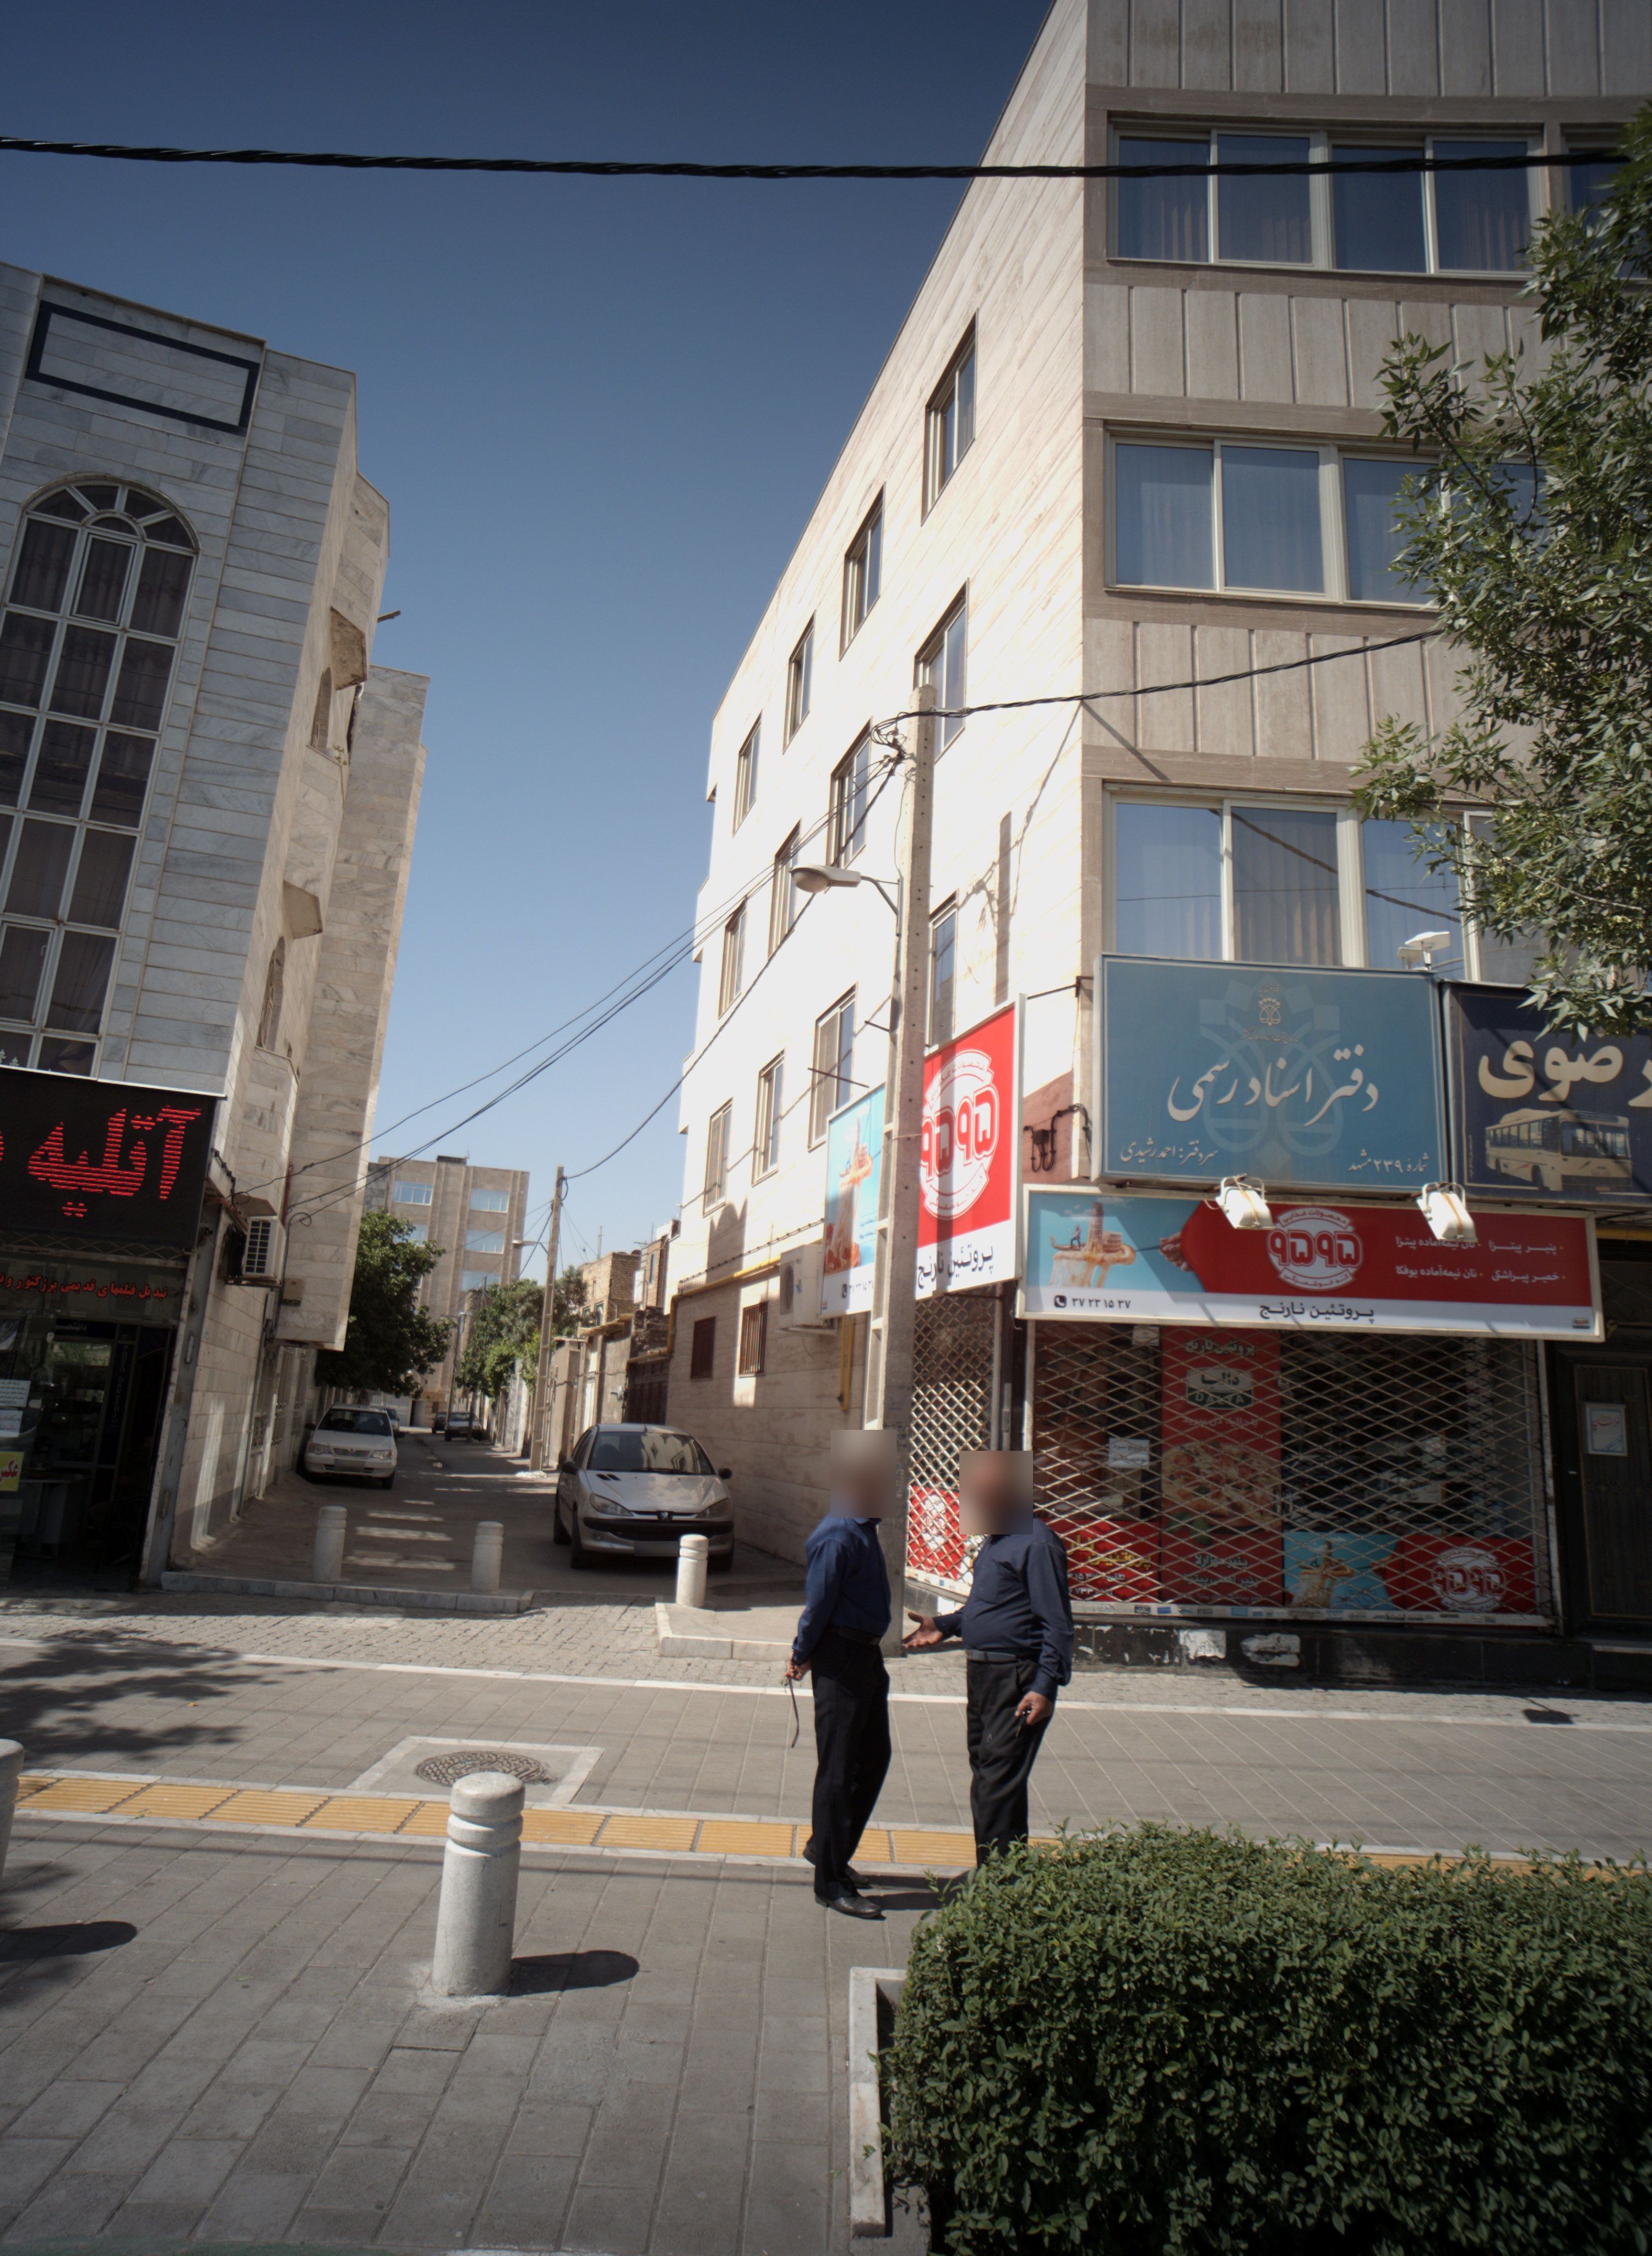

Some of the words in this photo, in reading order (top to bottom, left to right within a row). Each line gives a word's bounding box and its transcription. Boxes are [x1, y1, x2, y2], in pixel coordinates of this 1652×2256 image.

[1167, 1060, 1238, 1121] رسمی
[1244, 1058, 1312, 1107] اسناد
[1303, 1044, 1379, 1127] دفتر
[1120, 1136, 1156, 1163] رشیدی
[1156, 1145, 1176, 1158] احمد
[28, 1105, 202, 1218] آتلیه
[1347, 1148, 1372, 1172] مشهد
[1374, 1159, 1403, 1174] ۲۳۹
[1268, 1230, 1362, 1268] ۹۵۹۵
[1395, 1235, 1417, 1250] پیتزا
[1488, 1239, 1522, 1255] پیتزا
[1525, 1243, 1557, 1256] پنیر
[917, 1251, 944, 1289] نارنج
[948, 1244, 994, 1278] پروتئین
[1463, 1268, 1477, 1279] نان
[1491, 1269, 1530, 1284] پیراشکی
[1531, 1272, 1559, 1283] خمیر
[1072, 1298, 1085, 1308] ۳۷
[1104, 1299, 1115, 1309] ۱۵
[1118, 1300, 1132, 1309] ۳۷
[1259, 1301, 1305, 1319] نارنج
[1310, 1303, 1374, 1324] پروتئین
[1194, 1392, 1245, 1405] DALYA
